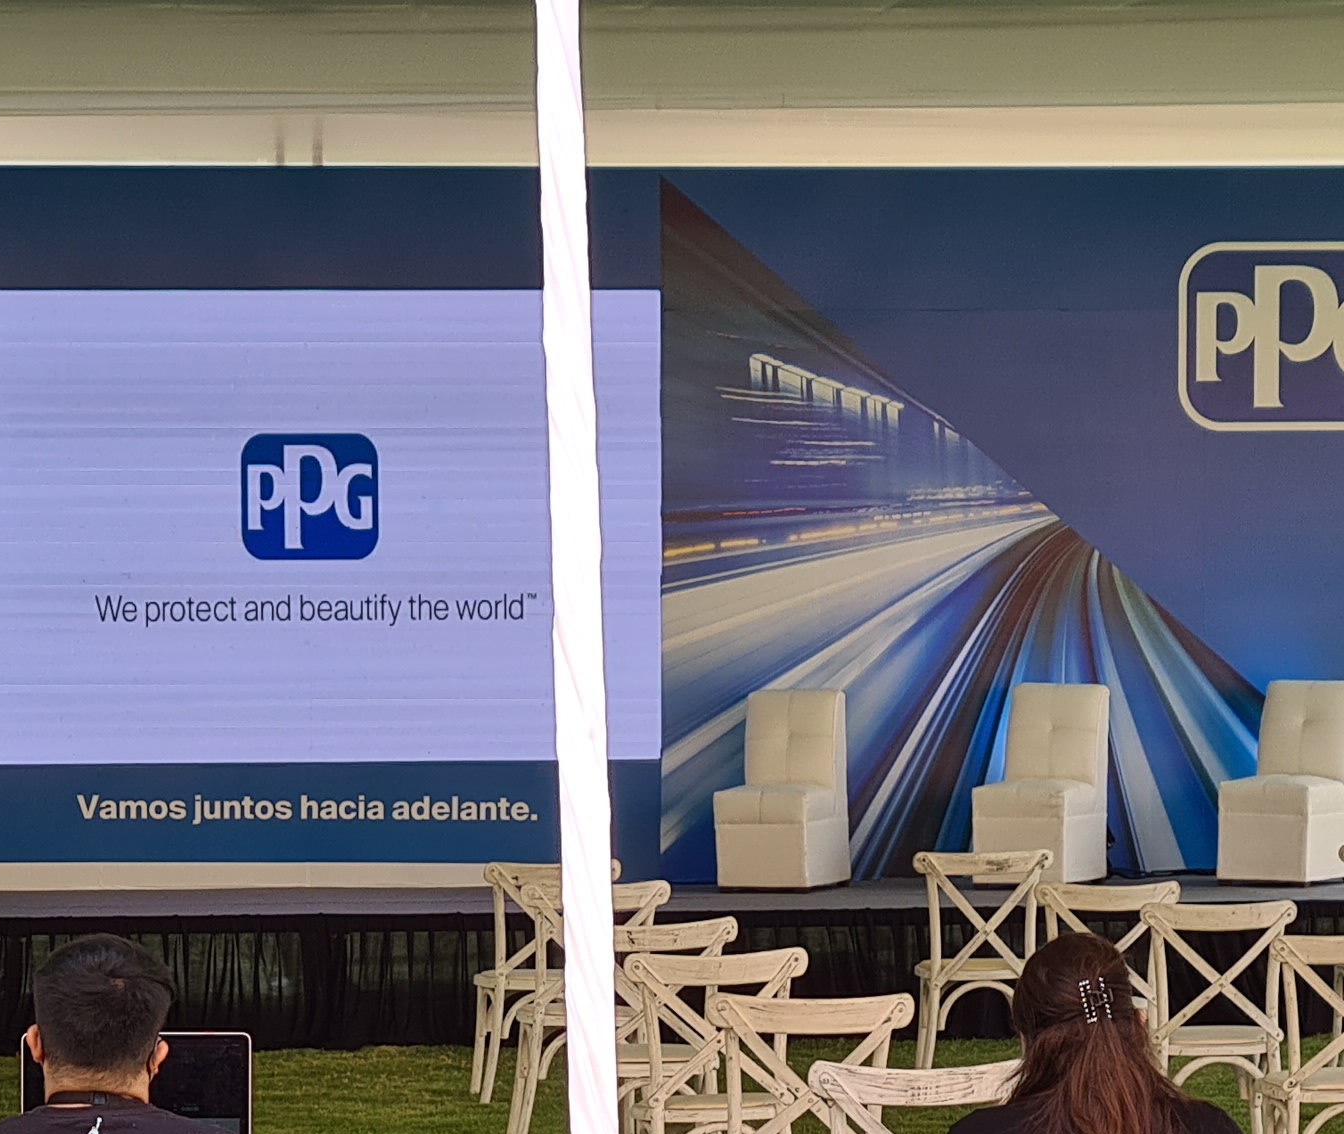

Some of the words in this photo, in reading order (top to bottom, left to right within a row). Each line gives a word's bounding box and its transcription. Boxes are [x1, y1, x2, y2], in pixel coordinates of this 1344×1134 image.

[247, 444, 373, 549] PPG
[94, 594, 138, 622] We
[145, 596, 237, 628] protect
[244, 594, 292, 622] and
[299, 593, 402, 627] beautify
[408, 593, 450, 621] the
[77, 795, 187, 820] Vamos
[192, 794, 292, 825] juntos
[300, 795, 384, 820] hacia
[392, 795, 539, 821] adelante.
